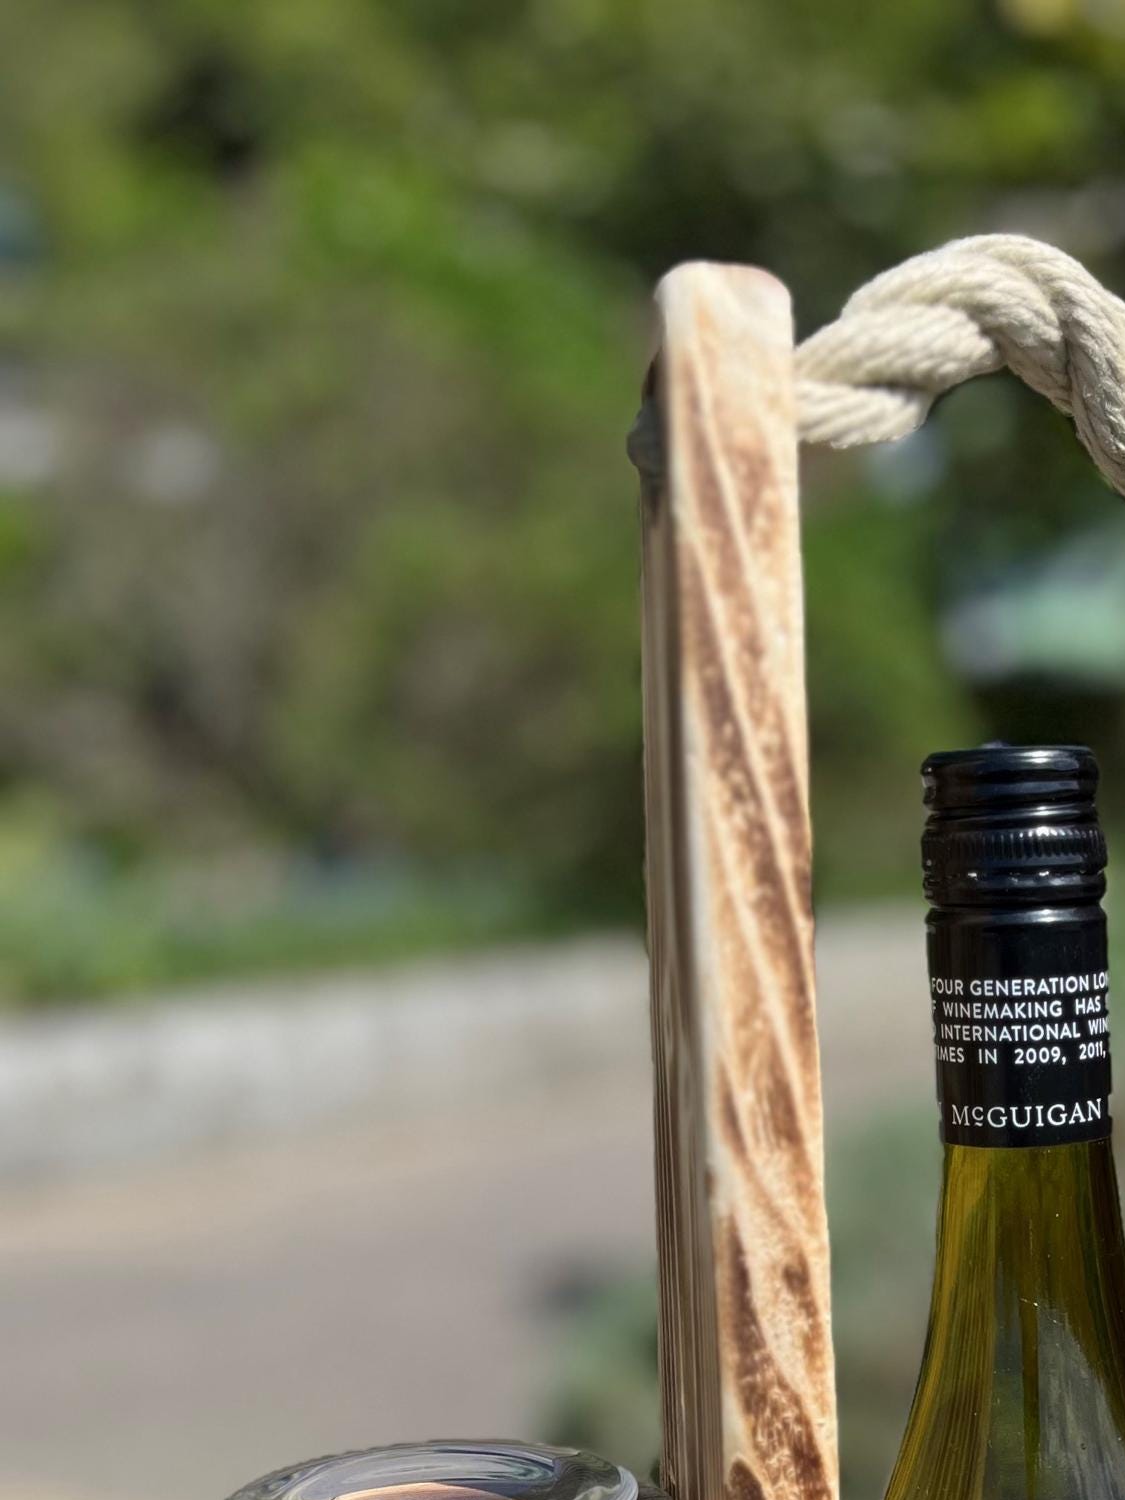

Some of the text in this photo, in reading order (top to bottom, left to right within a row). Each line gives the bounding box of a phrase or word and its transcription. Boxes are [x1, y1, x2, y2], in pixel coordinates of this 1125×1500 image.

[931, 971, 1109, 997] FOUR GENERATION LO
[942, 1000, 1063, 1019] WINEMAKING
[1075, 995, 1102, 1015] HAS
[940, 1022, 1081, 1041] INTERNATIONAL
[937, 1040, 1106, 1065] IMES IN 2009, 2011,
